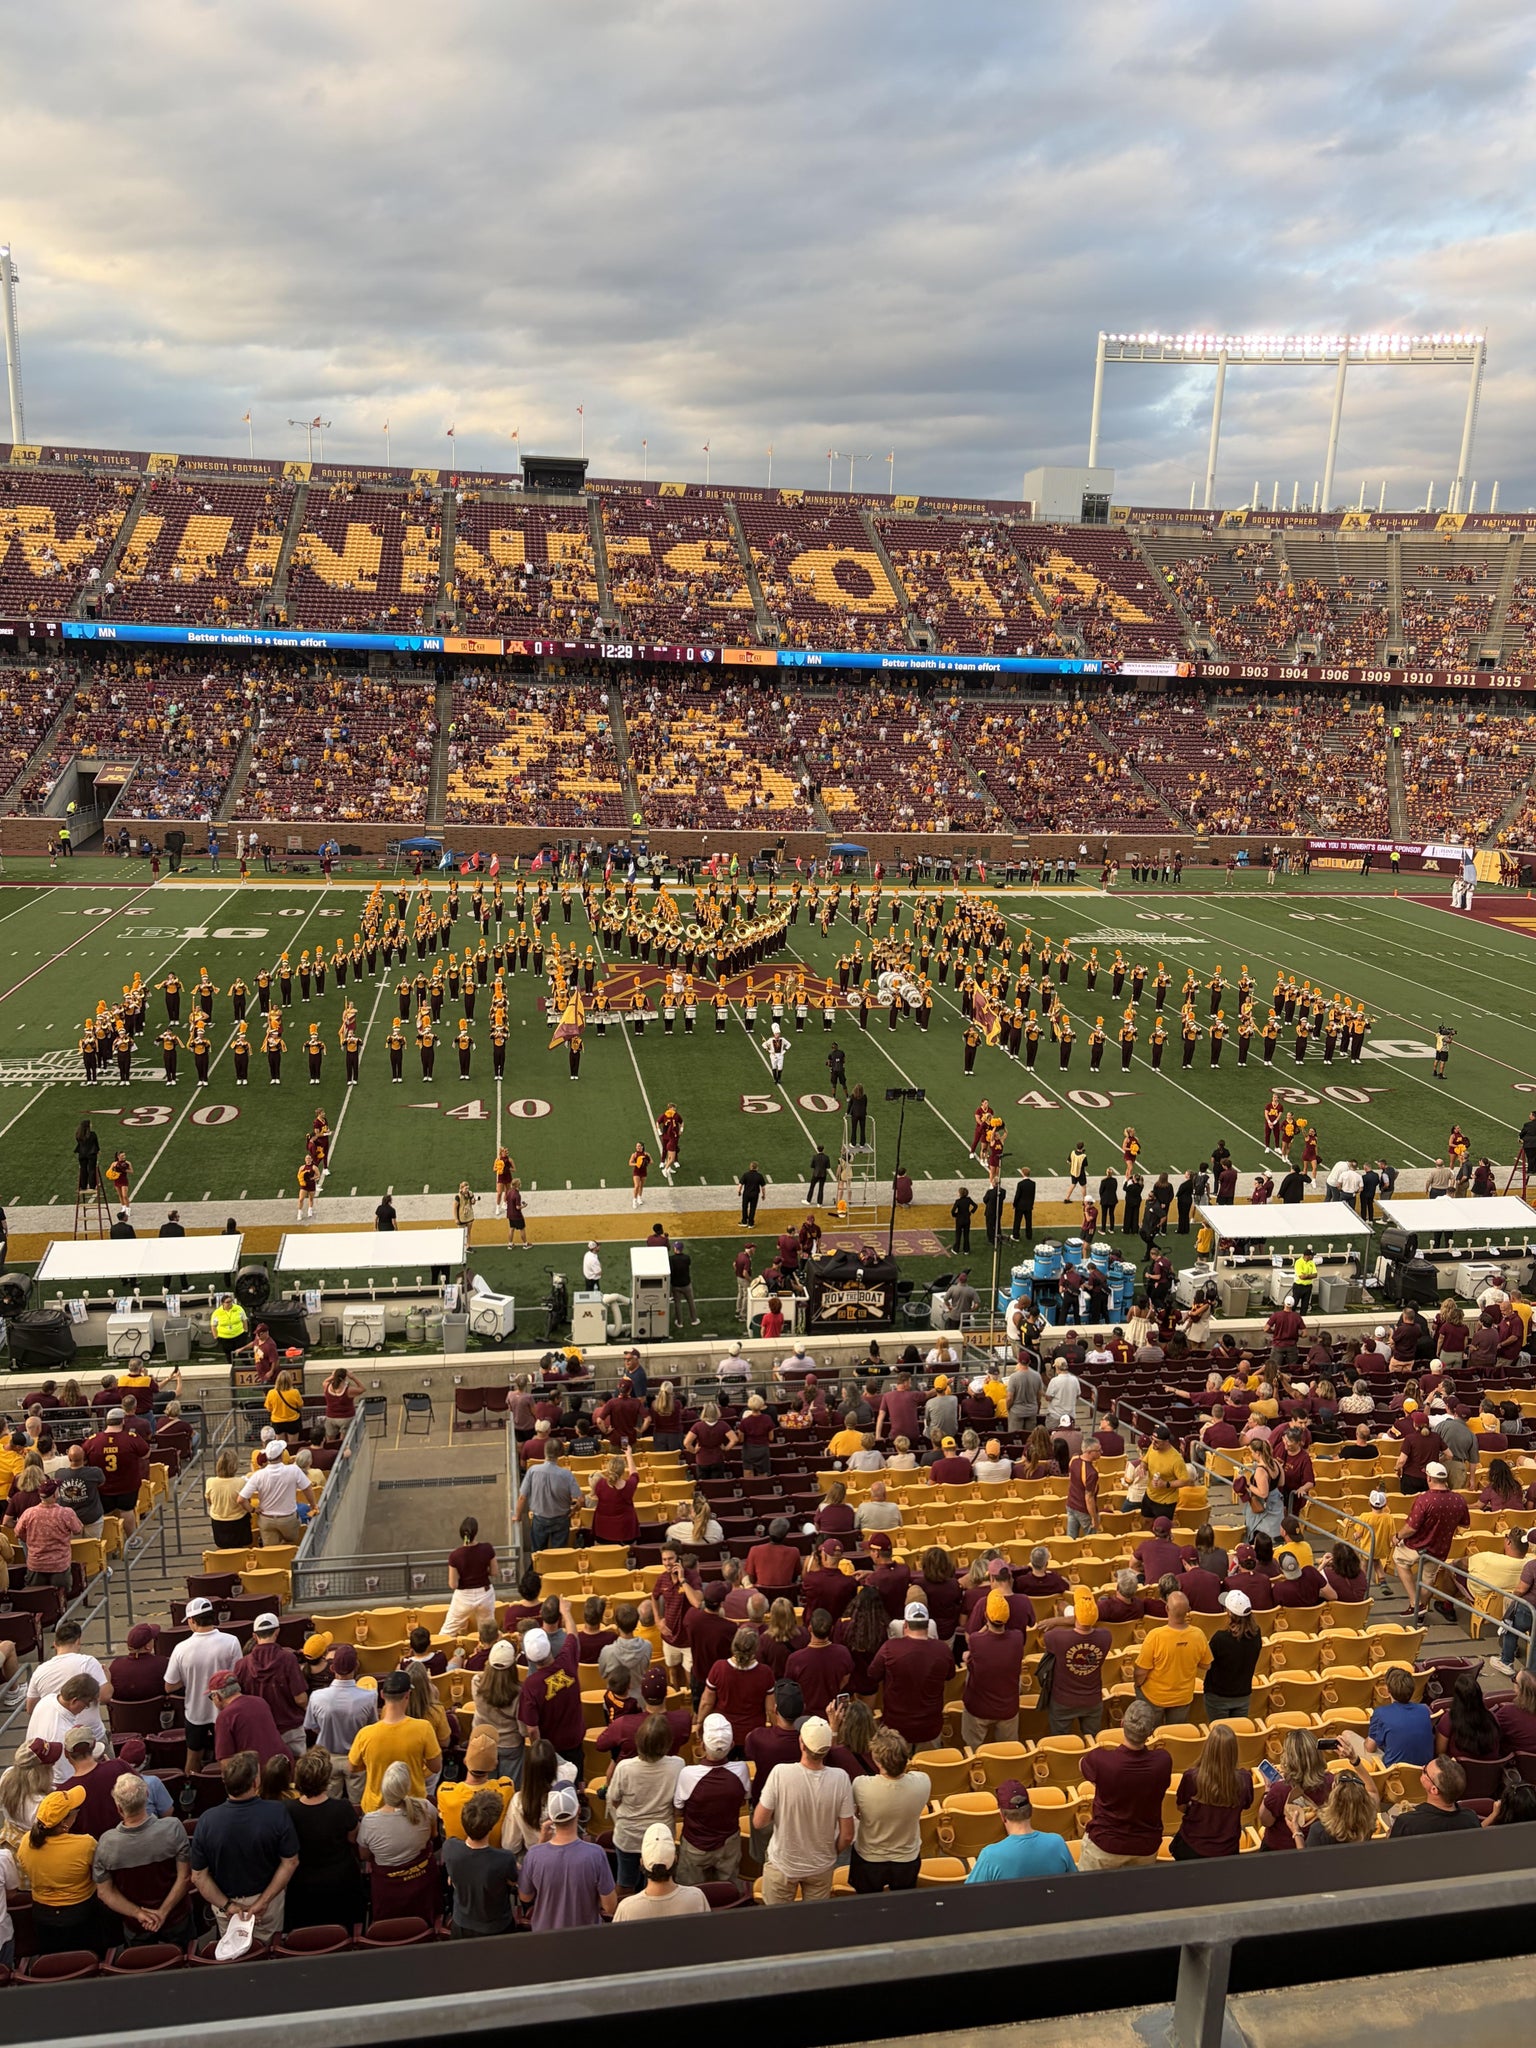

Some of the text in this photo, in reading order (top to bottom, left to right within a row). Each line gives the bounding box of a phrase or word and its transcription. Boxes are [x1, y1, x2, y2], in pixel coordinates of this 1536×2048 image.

[102, 455, 131, 465] TITLES
[321, 468, 353, 479] GOLDEN
[705, 489, 719, 499] BIG
[722, 490, 737, 500] TEN
[739, 492, 764, 502] TITLES
[804, 494, 847, 505] MINNESOTA
[1131, 511, 1211, 522] MINNESOTA FOOTBALL
[1252, 516, 1281, 525] GOLDEN
[1472, 519, 1478, 527] 7
[98, 628, 117, 638] MN
[187, 632, 219, 643] Better
[221, 634, 252, 644] health
[253, 635, 264, 645] is
[273, 637, 298, 646] team
[300, 637, 327, 648] effort
[423, 639, 440, 650] MN
[534, 641, 543, 655] 0
[600, 644, 633, 659] 12:29
[686, 647, 695, 661] 0
[806, 655, 823, 665] MN
[881, 658, 909, 668] Better
[910, 659, 937, 669] health
[938, 660, 946, 670] is
[954, 662, 976, 671] team
[977, 662, 1001, 672] effort
[1083, 663, 1099, 673] MN
[1201, 664, 1230, 677] 1900
[1240, 665, 1269, 678] 1903
[1279, 667, 1309, 679] 1904
[1319, 669, 1349, 681] 1906
[1360, 670, 1391, 683] 1909
[1402, 672, 1434, 685] 1910
[1445, 673, 1476, 686] 1911
[1488, 675, 1522, 688] 1915
[1310, 841, 1327, 849] THANK
[1348, 843, 1376, 851] TONIGHT'S
[1377, 844, 1393, 852] GAME
[1394, 845, 1422, 854] SPONSOR
[1016, 1089, 1114, 1110] 40
[1270, 1086, 1374, 1106] 30
[443, 1098, 554, 1121] 40
[739, 1093, 841, 1114] 50
[120, 1104, 241, 1127] 30
[824, 1291, 882, 1304] ROW THE BOAT
[966, 1335, 984, 1345] 141
[239, 1374, 261, 1385] 142
[105, 1454, 118, 1472] 3
[1064, 1643, 1104, 1661] MINNESOTA
